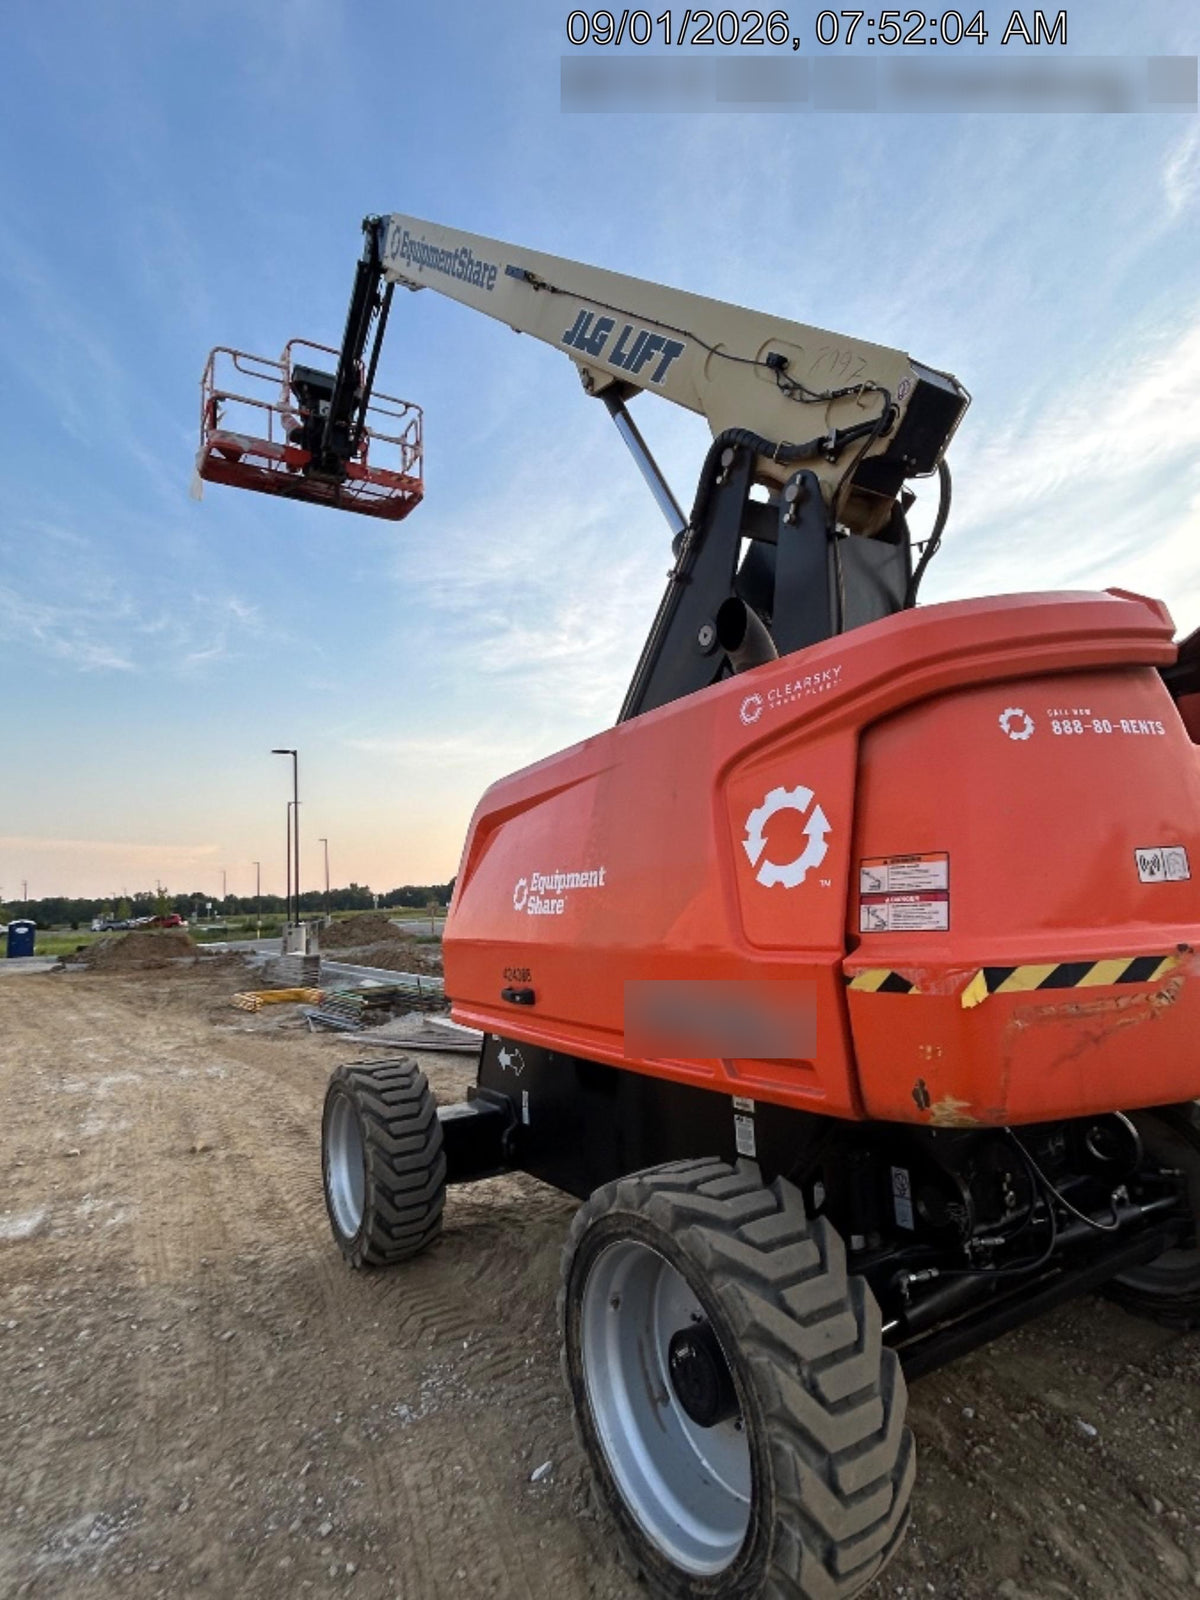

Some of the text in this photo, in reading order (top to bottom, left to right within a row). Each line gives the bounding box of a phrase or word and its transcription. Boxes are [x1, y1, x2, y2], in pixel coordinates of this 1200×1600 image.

[400, 230, 498, 291] EquipmentShare
[562, 307, 686, 385] JLG LIFT
[767, 664, 842, 701] CLEARSKY
[1051, 719, 1166, 736] 888-80-RENTS
[530, 866, 607, 895] Equipment
[527, 895, 565, 915] Share
